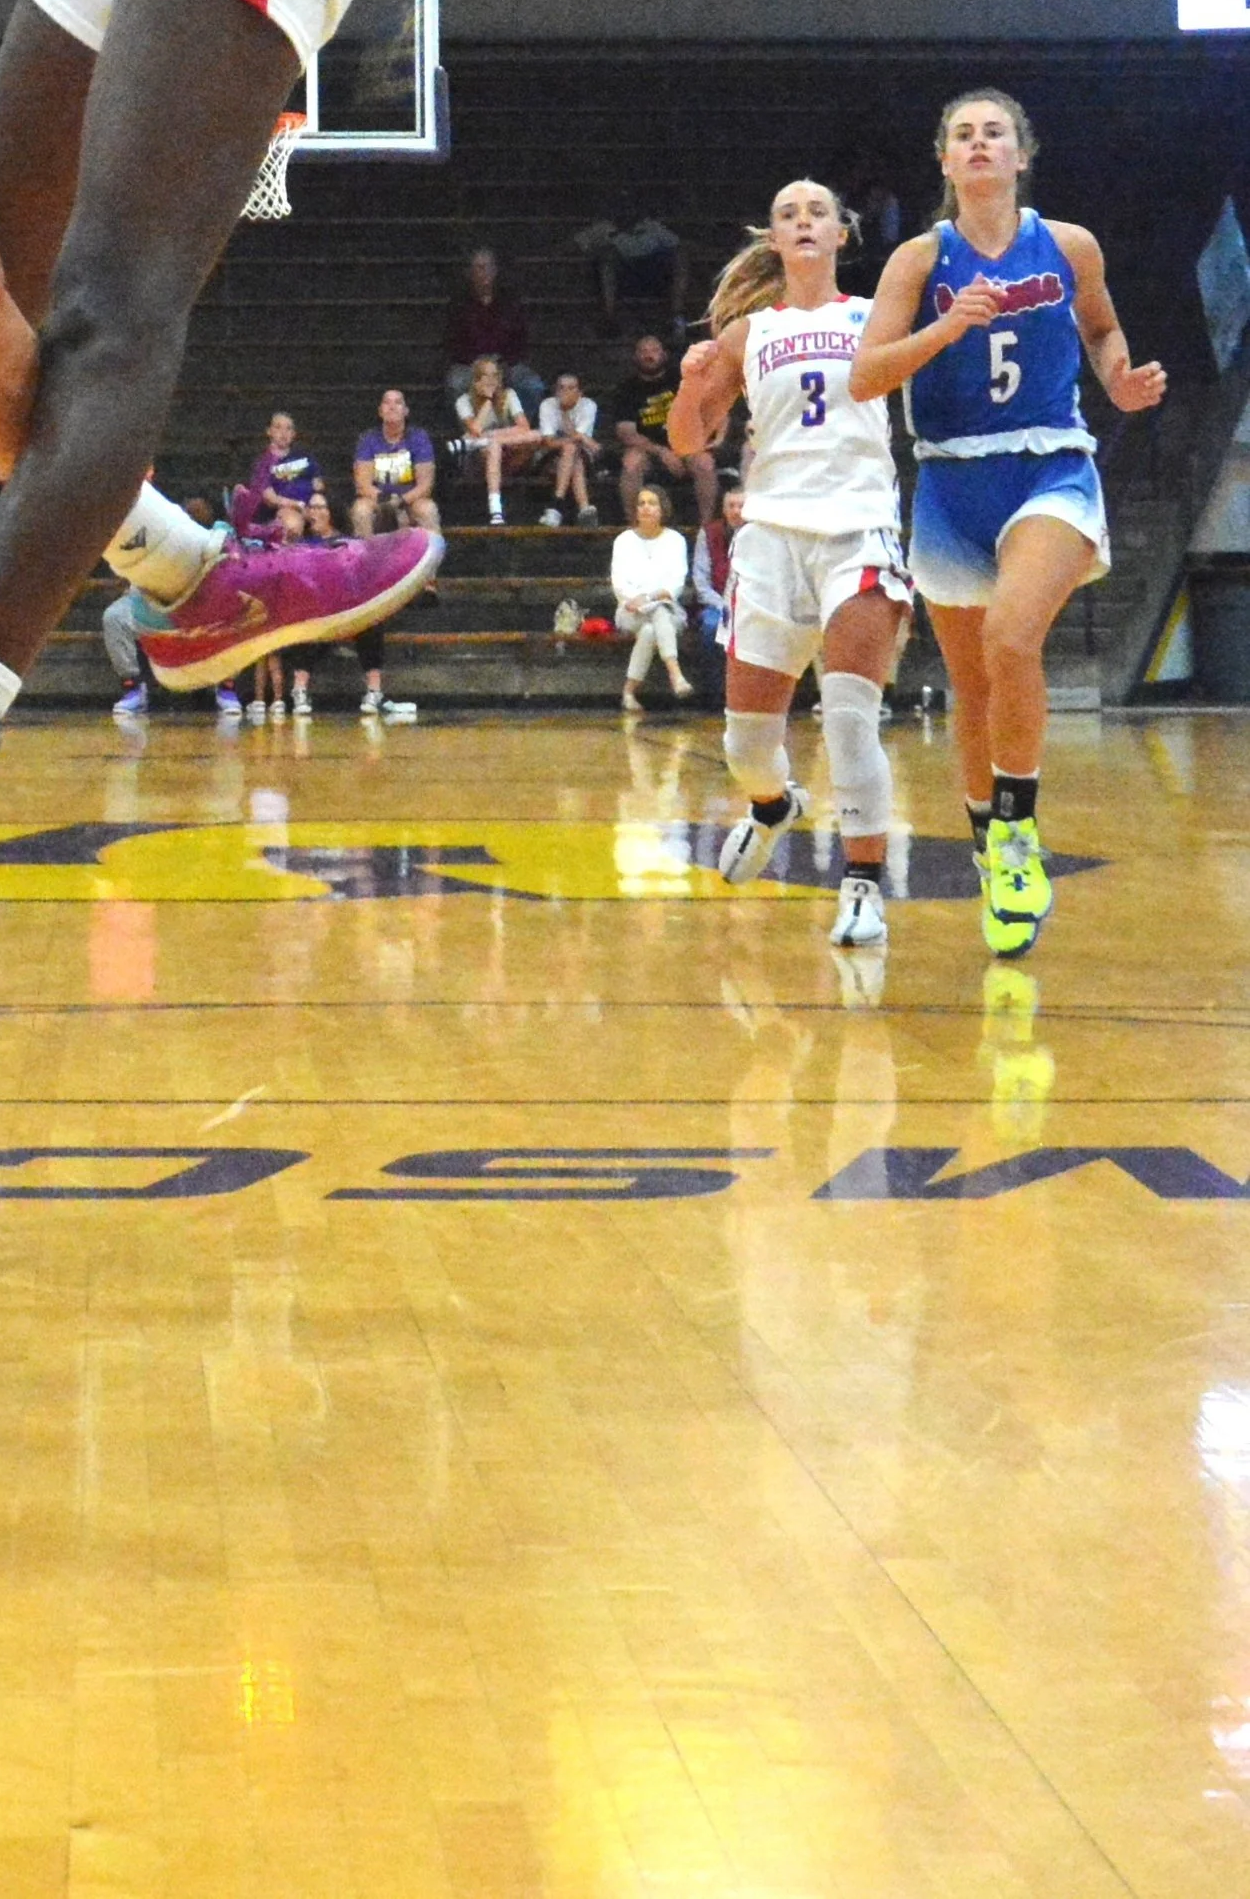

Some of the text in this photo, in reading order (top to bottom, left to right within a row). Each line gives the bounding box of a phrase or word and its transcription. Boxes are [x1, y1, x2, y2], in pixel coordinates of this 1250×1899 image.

[757, 331, 860, 382] KENTUCK
[989, 331, 1022, 404] 5
[801, 371, 826, 427] 3
